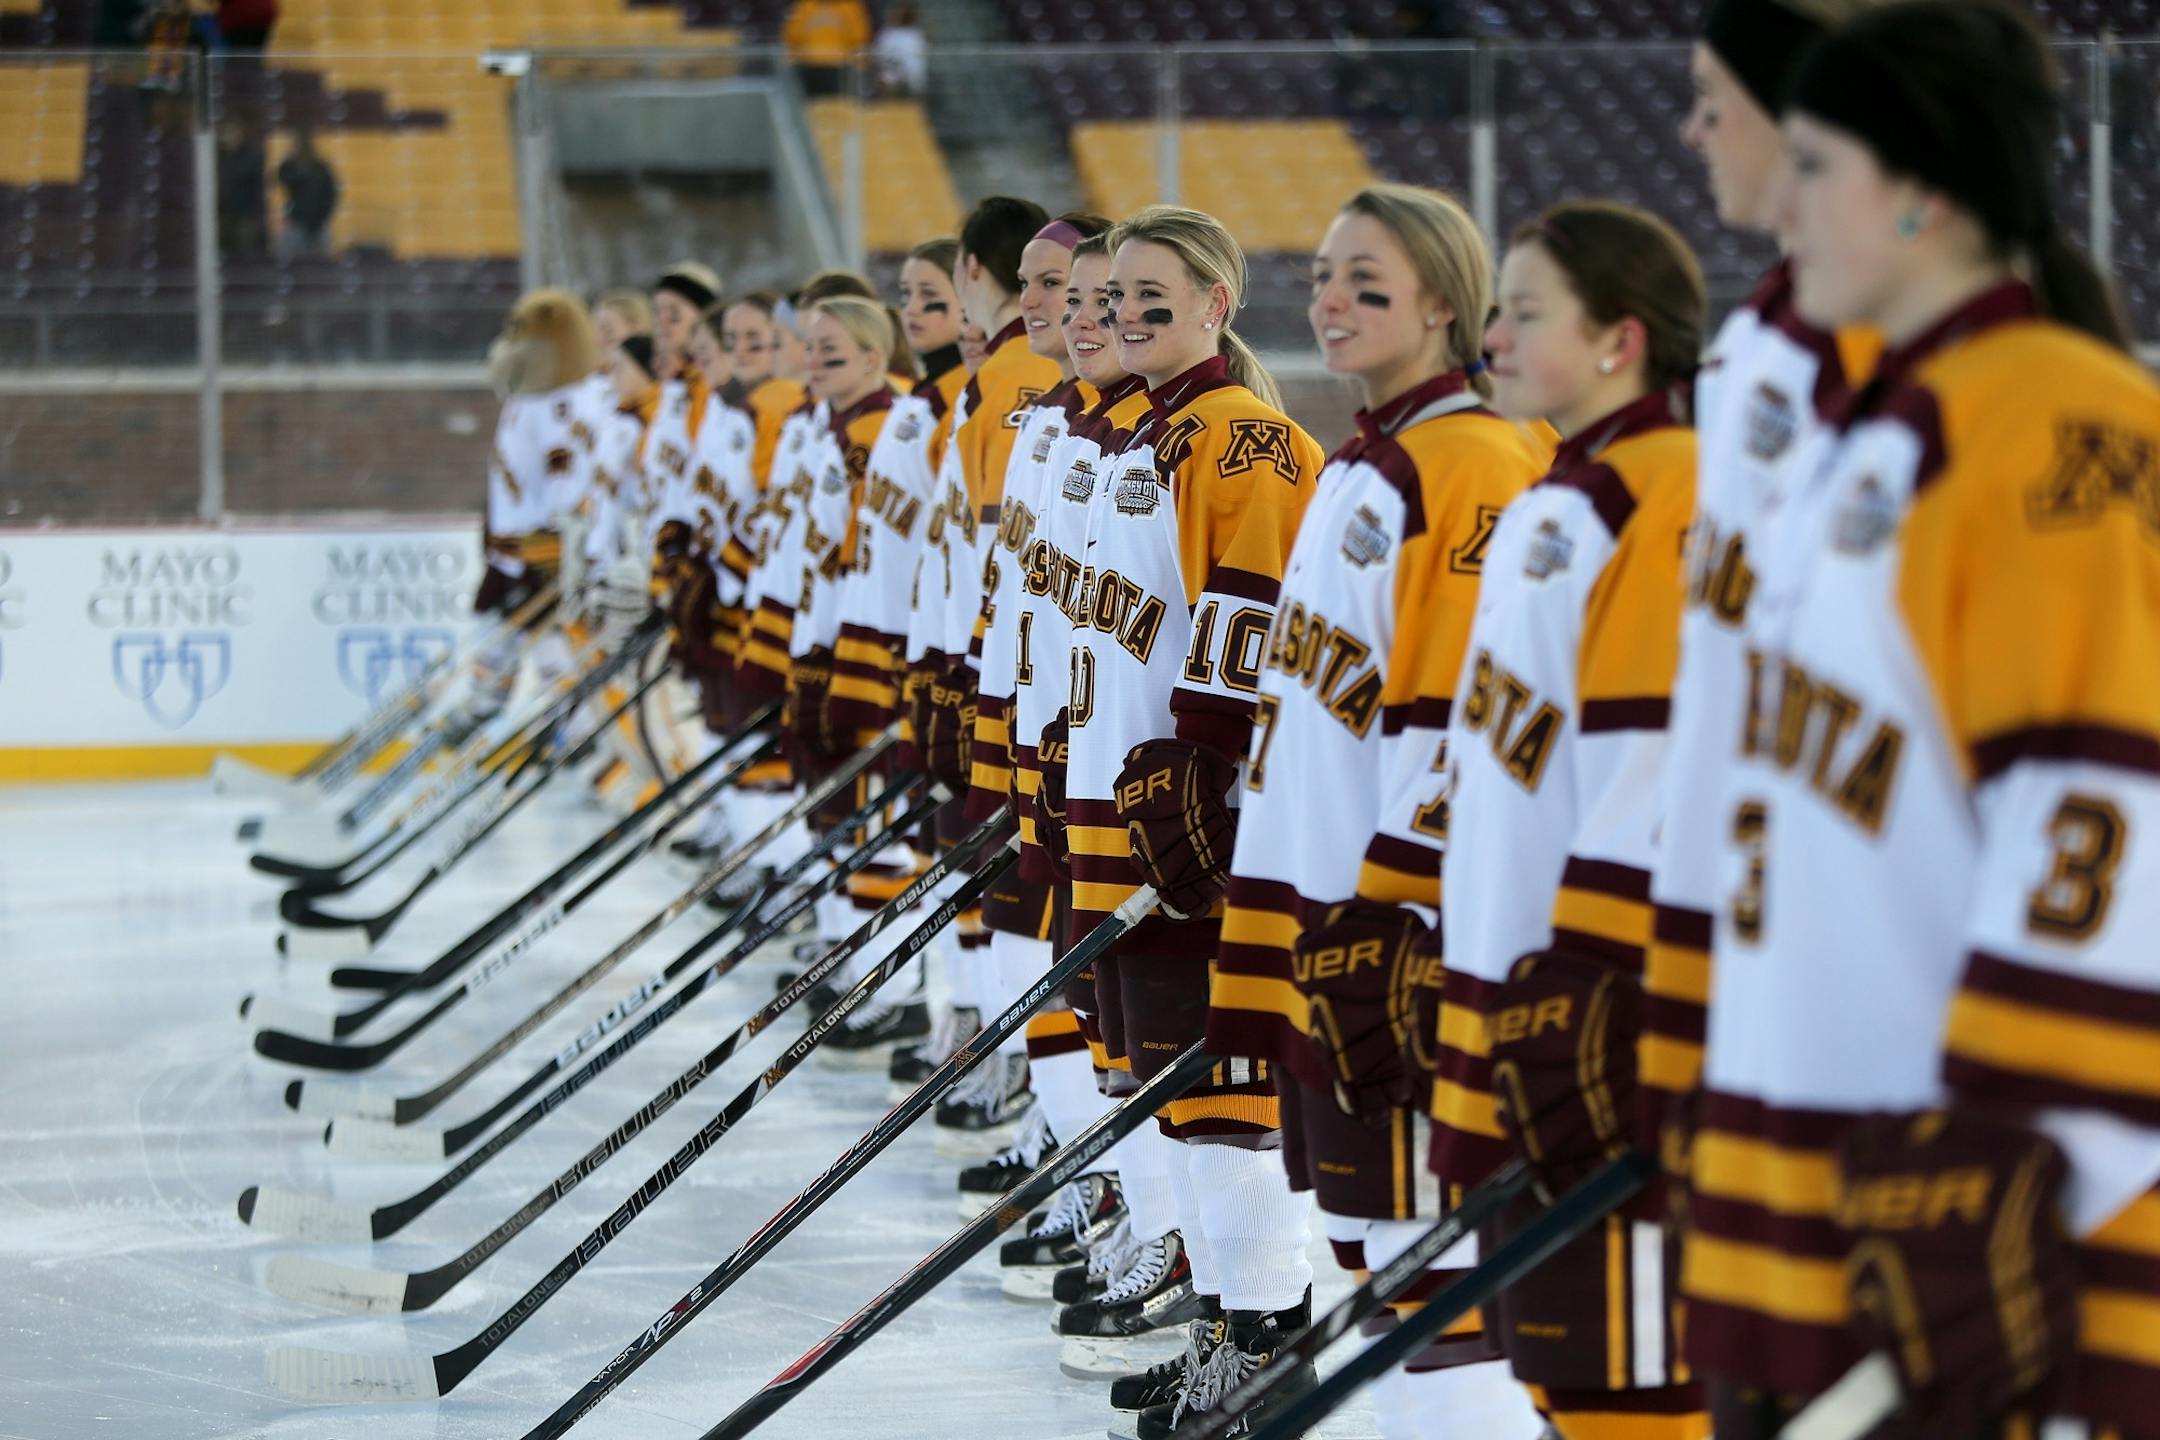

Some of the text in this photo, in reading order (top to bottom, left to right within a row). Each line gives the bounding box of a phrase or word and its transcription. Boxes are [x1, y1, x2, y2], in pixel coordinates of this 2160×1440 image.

[101, 547, 241, 587] MAYO
[326, 547, 467, 586] MAYO
[87, 588, 255, 628] CLINIC
[1184, 600, 1273, 691] 10
[895, 862, 948, 913] BAUER
[2022, 792, 2128, 946] 3
[909, 901, 958, 952] BAUER
[999, 979, 1051, 1032] BAUER
[1051, 1129, 1118, 1186] BAUER
